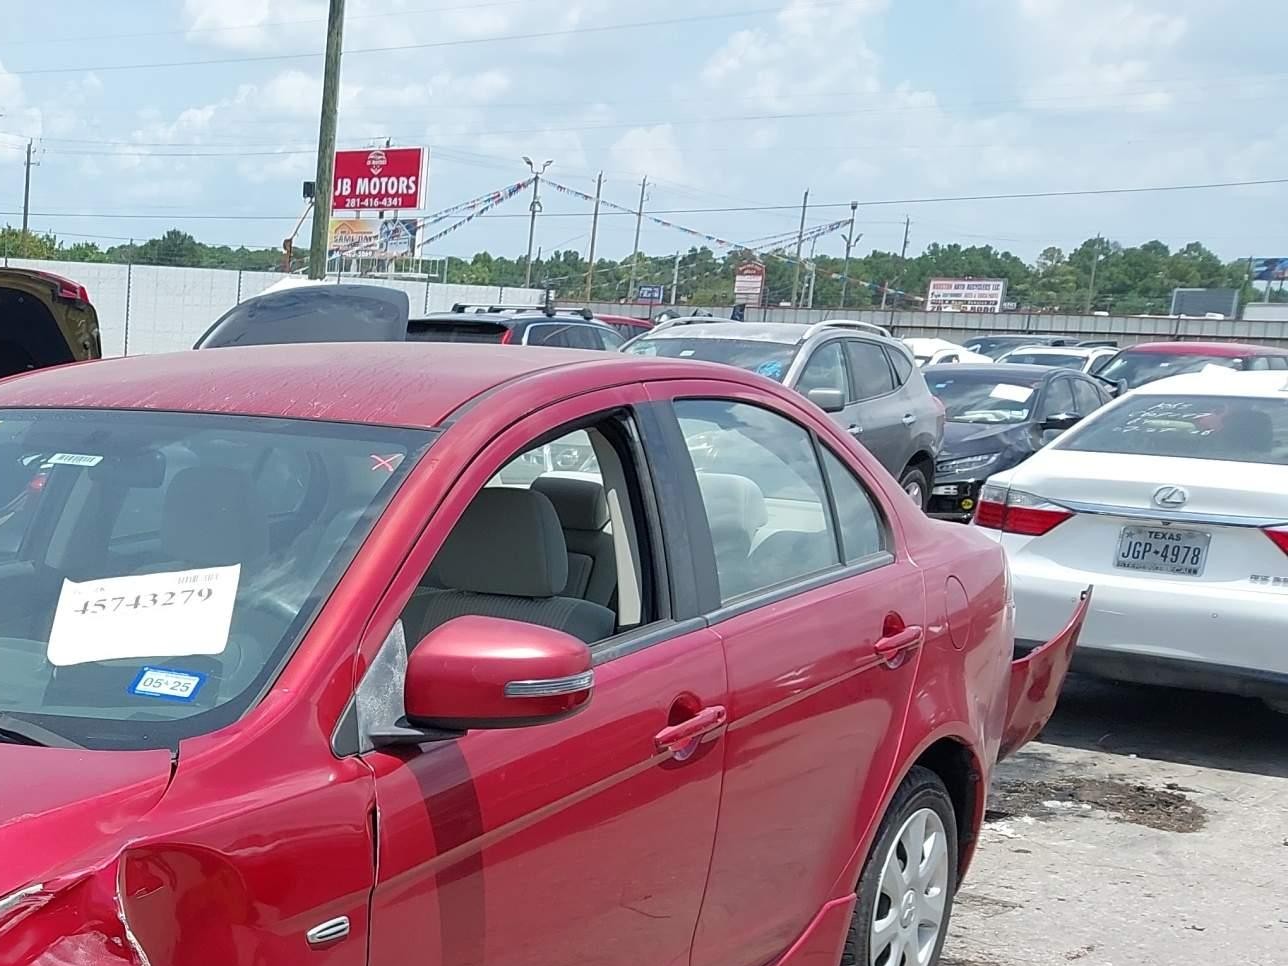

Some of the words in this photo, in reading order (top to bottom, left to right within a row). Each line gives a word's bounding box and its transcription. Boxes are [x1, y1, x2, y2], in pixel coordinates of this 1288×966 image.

[334, 178, 352, 196] JB
[355, 176, 417, 195] MOTORS
[1148, 530, 1183, 542] TEXAS
[73, 587, 214, 615] 45743279
